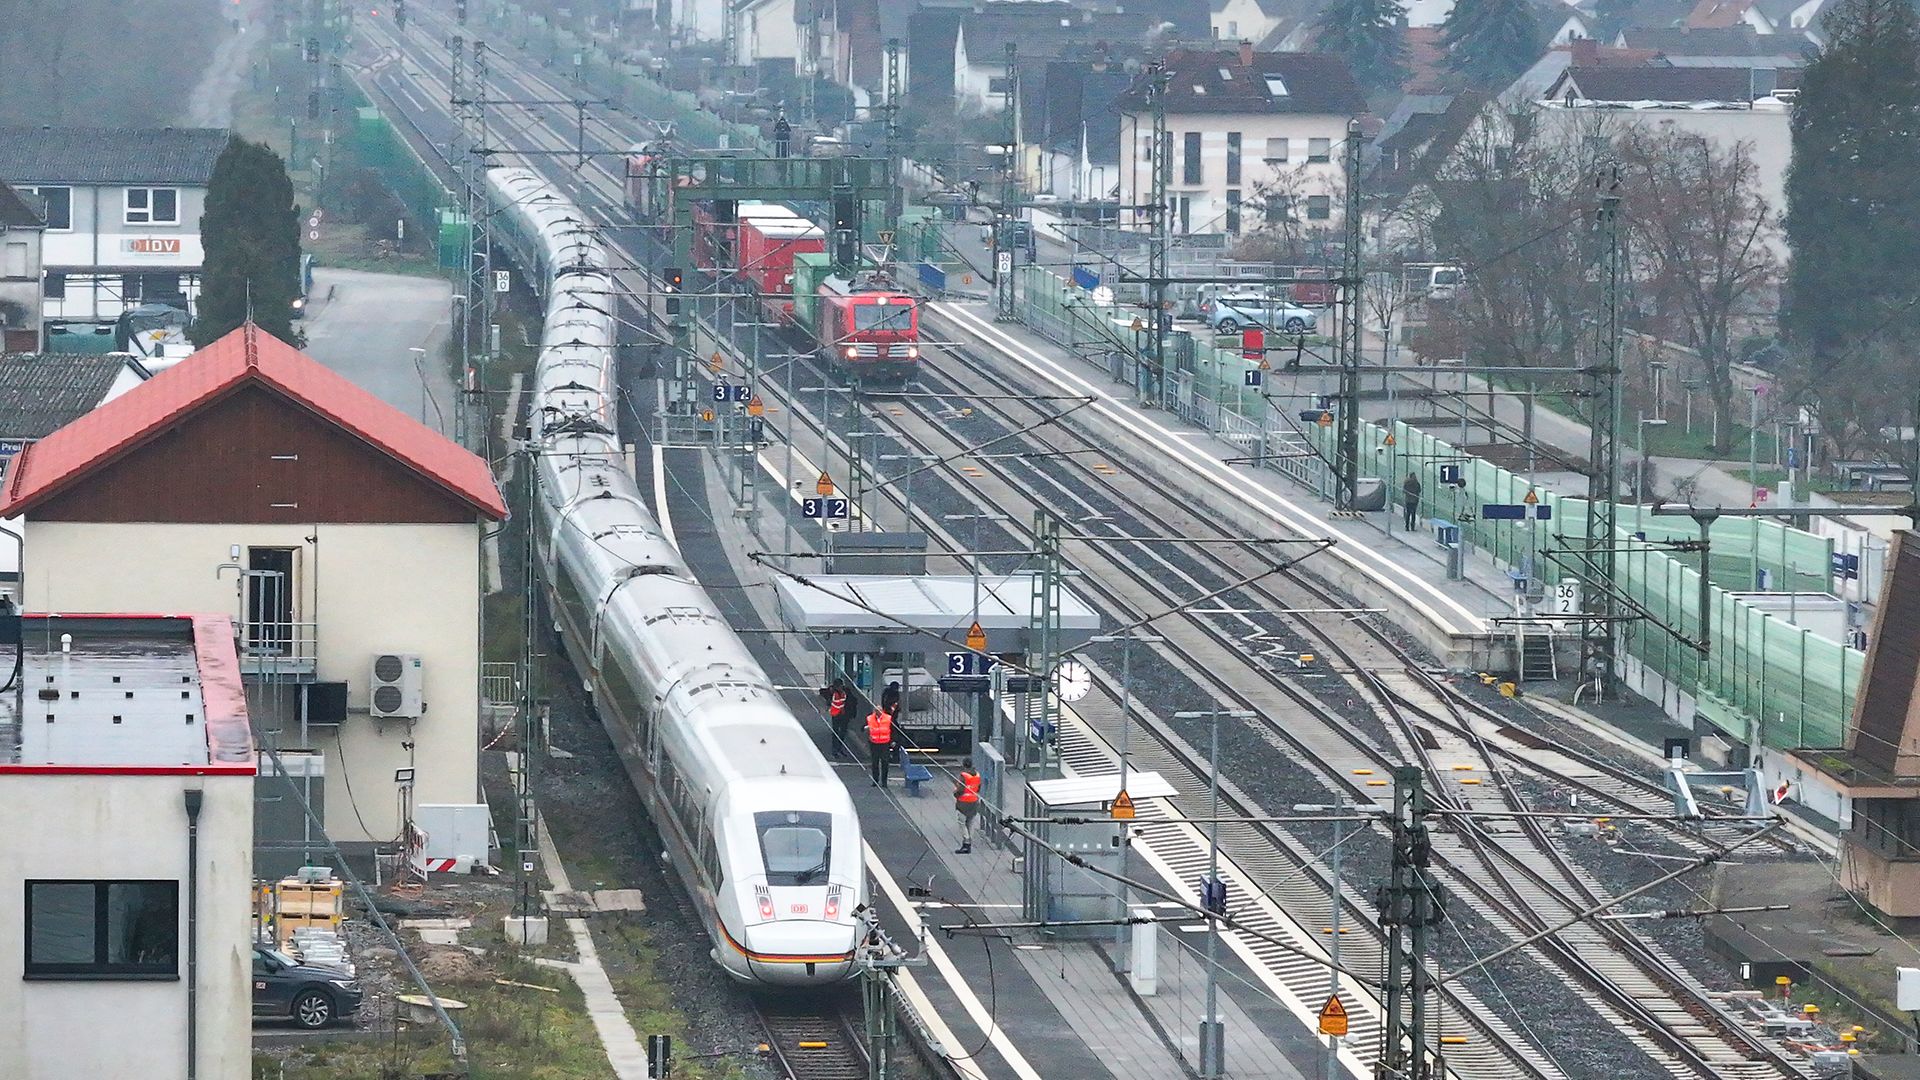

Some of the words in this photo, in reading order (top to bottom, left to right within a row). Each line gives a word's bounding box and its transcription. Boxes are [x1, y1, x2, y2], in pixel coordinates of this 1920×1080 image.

[145, 240, 175, 251] IDV
[1000, 253, 1010, 261] 36
[1001, 262, 1008, 271] 0
[498, 272, 509, 280] 36
[500, 281, 506, 289] 0
[1247, 371, 1253, 384] 1
[715, 386, 725, 400] 3
[740, 387, 749, 400] 2
[1442, 466, 1449, 481] 1
[805, 500, 816, 516] 3
[834, 500, 845, 516] 2
[1558, 584, 1574, 598] 36
[1561, 600, 1569, 612] 2
[952, 655, 965, 674] 3
